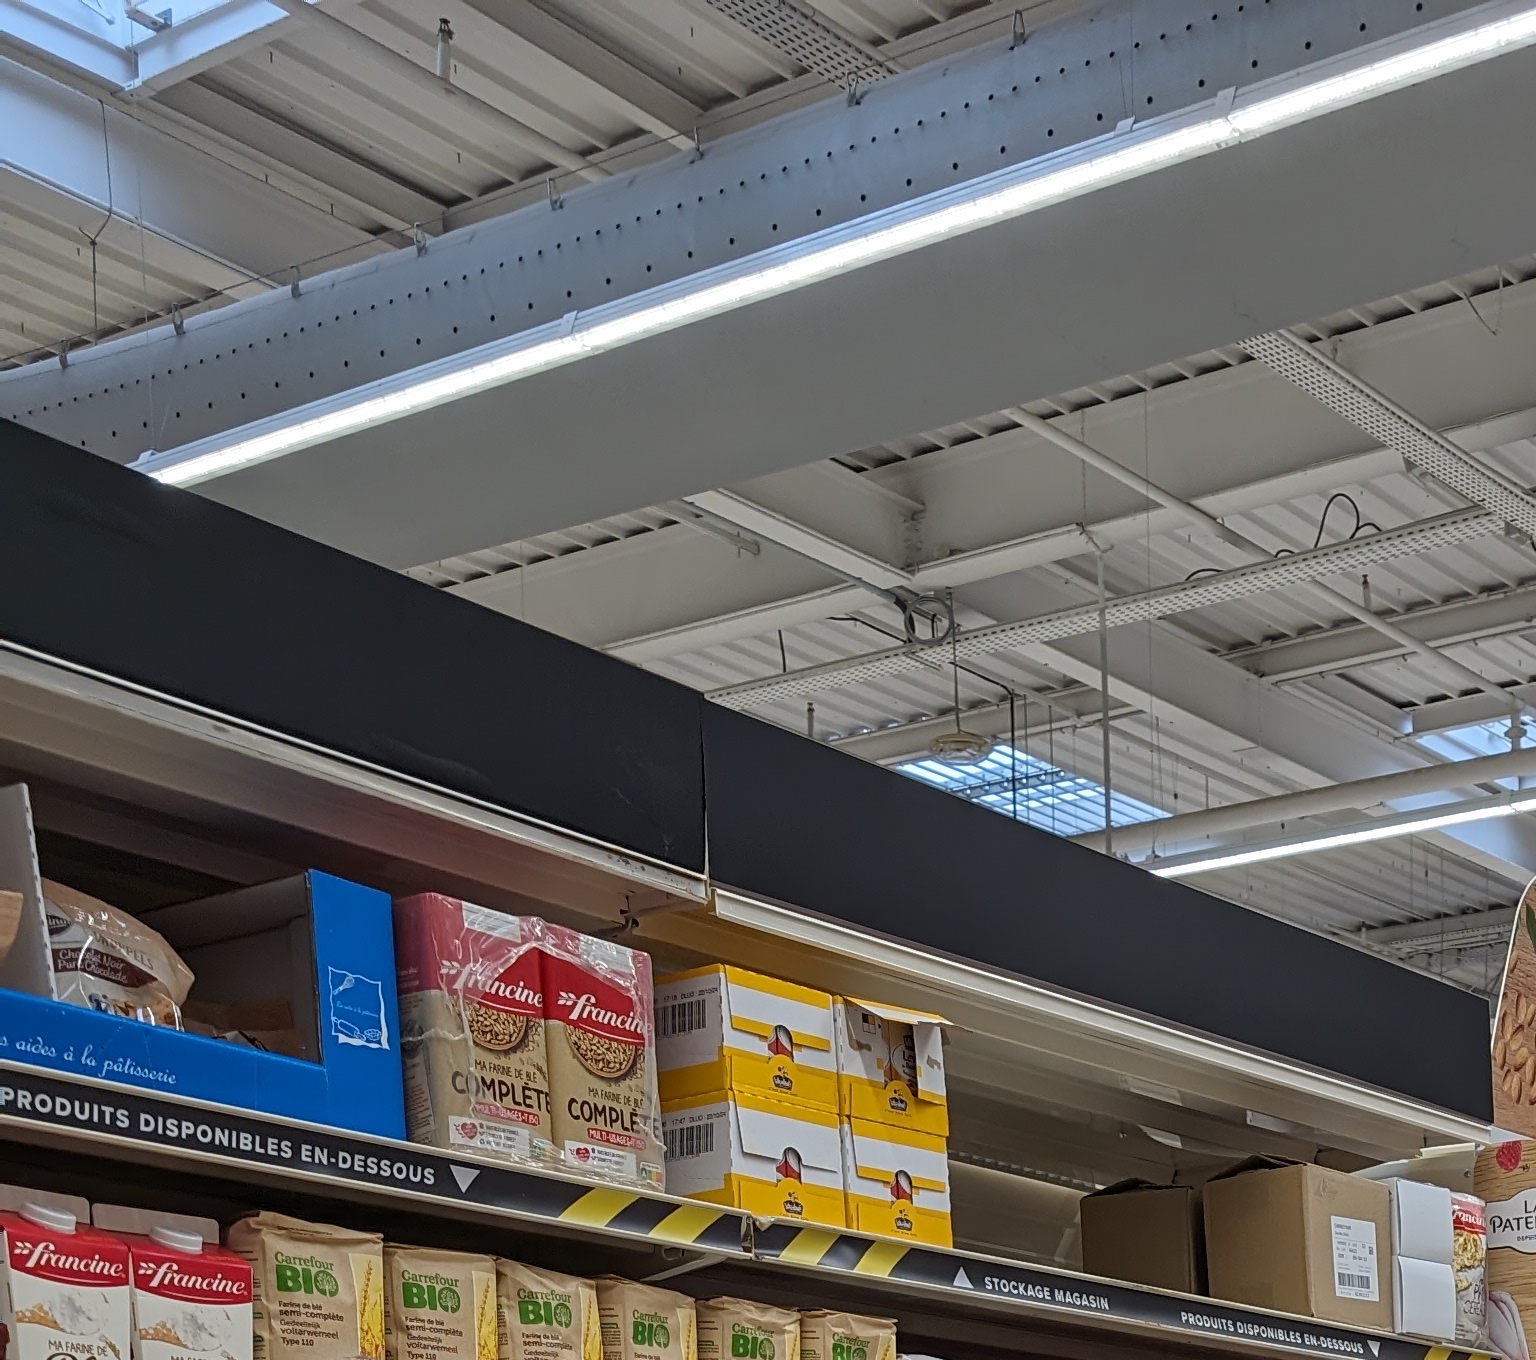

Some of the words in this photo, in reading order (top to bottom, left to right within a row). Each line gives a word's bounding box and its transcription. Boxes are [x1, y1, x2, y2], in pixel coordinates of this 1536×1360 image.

[16, 1036, 57, 1058] aides
[64, 1045, 74, 1061] à
[81, 1045, 97, 1067] la
[98, 1056, 177, 1085] pâtisserie
[451, 1071, 550, 1115] COMPLÈTE
[0, 1087, 130, 1128] PRODUITS
[140, 1113, 292, 1159] DISPONIBLES
[301, 1144, 436, 1185] EN-DESSOUS
[26, 1242, 124, 1277] francine
[275, 1251, 335, 1270] Carrefour
[150, 1262, 246, 1296] francine
[276, 1265, 339, 1298] BIO
[401, 1269, 459, 1289] Carrefour
[984, 1276, 1051, 1301] STOCKAGE
[1054, 1287, 1110, 1311] MAGASIN
[402, 1281, 462, 1313] BIO
[517, 1288, 571, 1304] Carrefour
[518, 1300, 572, 1328] BIO
[632, 1320, 671, 1349] BIO
[1180, 1311, 1235, 1333] PRODUITS
[1236, 1321, 1302, 1345] DISPONIBLES
[1304, 1332, 1364, 1355] EN-DESSOUS
